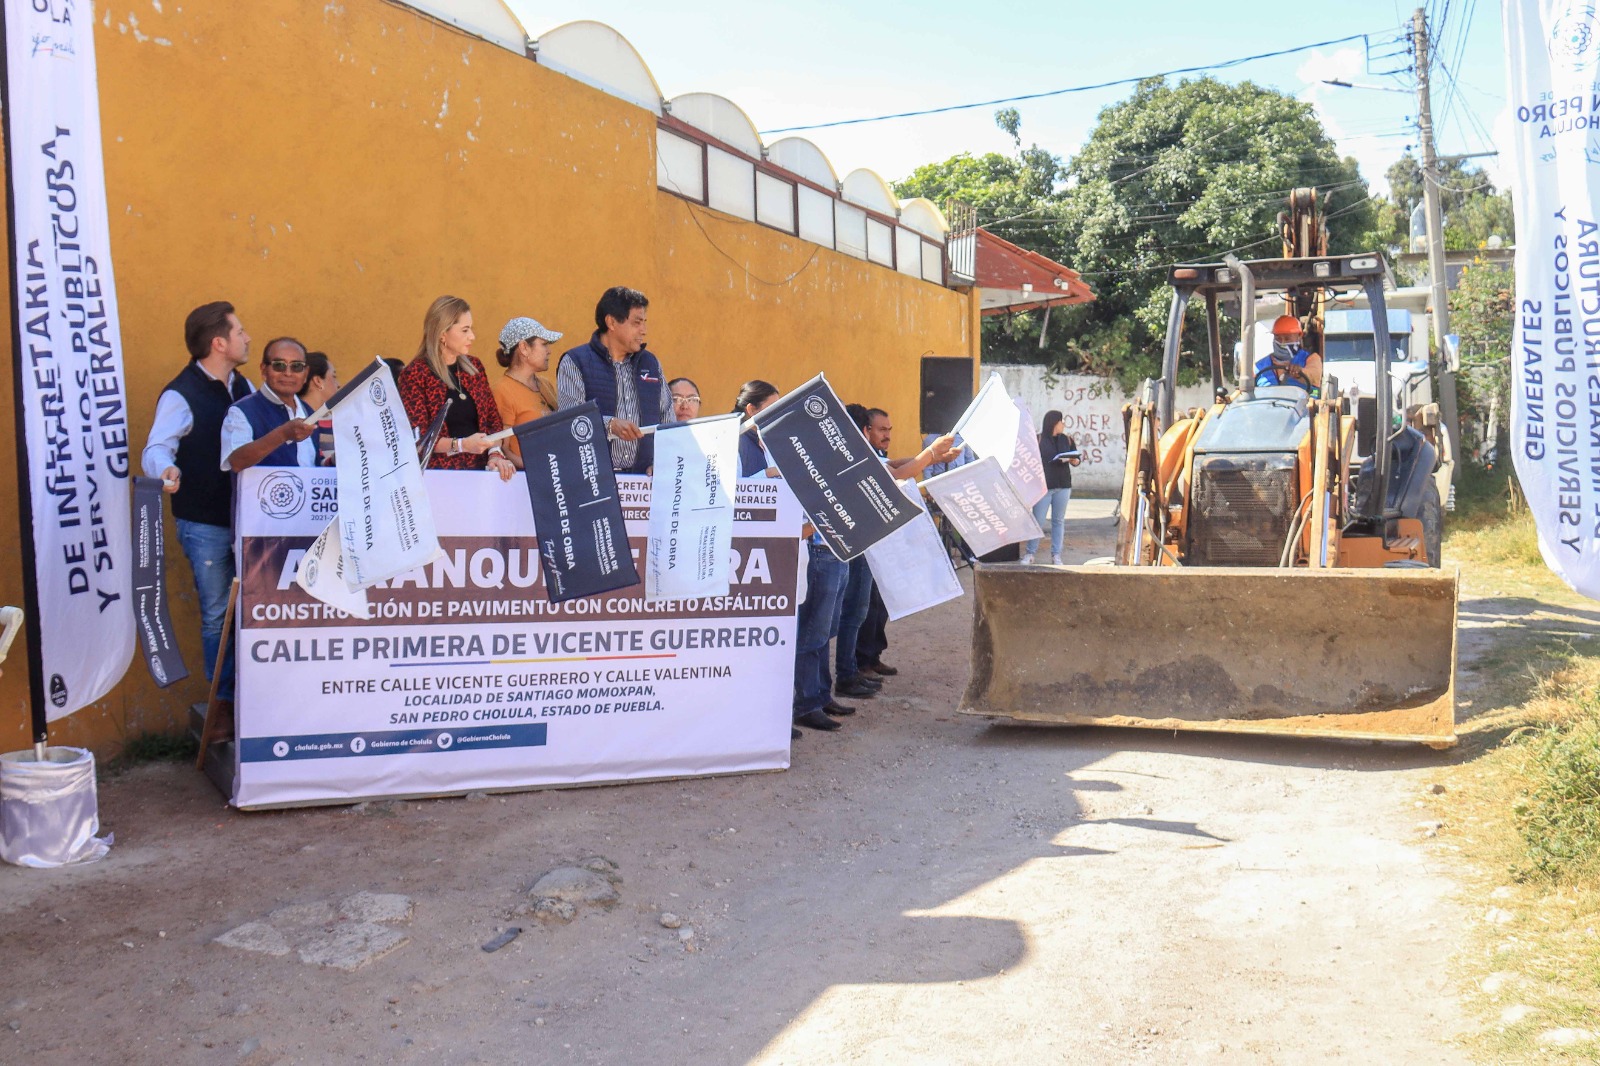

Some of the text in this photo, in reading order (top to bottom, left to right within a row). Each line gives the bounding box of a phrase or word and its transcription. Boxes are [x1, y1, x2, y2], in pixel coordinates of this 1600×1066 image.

[85, 255, 130, 479] GENERALES
[380, 411, 390, 448] CHOLULA
[384, 408, 399, 466] SAN PEDRO
[818, 421, 838, 451] CHOLULA
[823, 418, 855, 462] SAN PEDRO
[1064, 414, 1111, 431] ONER
[75, 368, 114, 574] SERVICIOS
[311, 478, 338, 486] GOBIE
[579, 445, 589, 480] CHOLULA
[584, 443, 600, 497] SAN PEDRO
[789, 435, 856, 530] ARRANQUE DE OBRA
[311, 487, 338, 500] SA
[353, 425, 374, 552] ARRANQUE DE OBRA
[708, 474, 717, 506] PEDRO
[734, 495, 778, 505] NERALES
[860, 479, 894, 522] INFRAESTRUCTURA
[866, 475, 893, 510] SECRETARÍA
[890, 505, 901, 517] DE
[394, 489, 412, 551] INFRAESTRUCTURA
[400, 486, 420, 545] SECRETARÍA DE
[547, 453, 576, 570] ARRANQUE DE OBRA
[668, 455, 685, 570] ARRANQUE DE OBRA
[602, 516, 619, 571] SECRETARÍA DE
[707, 525, 717, 577] SECRETARÍA DE
[63, 541, 90, 595] DE
[97, 588, 121, 614] Y
[251, 592, 789, 622] CONSTRUCIÓN DE PAVIMENTO CON CONCRETO ASFÁLTICO
[250, 626, 786, 663] CALLE PRIMERA DE VICENTE GUERRERO.
[322, 665, 732, 695] ENTRE CALLE VICENTE GUERRERO Y CALLE VALENTINA
[404, 685, 656, 707] LOCALIDAD DE SANTIAGO MOMOXPAN,
[389, 700, 665, 725] SAN PEDRO CHOLULA, ESTADO DE PUEBLA.
[294, 733, 512, 752] cholula.gob.mx Gobierno de Cholula @GobiernoCholula
